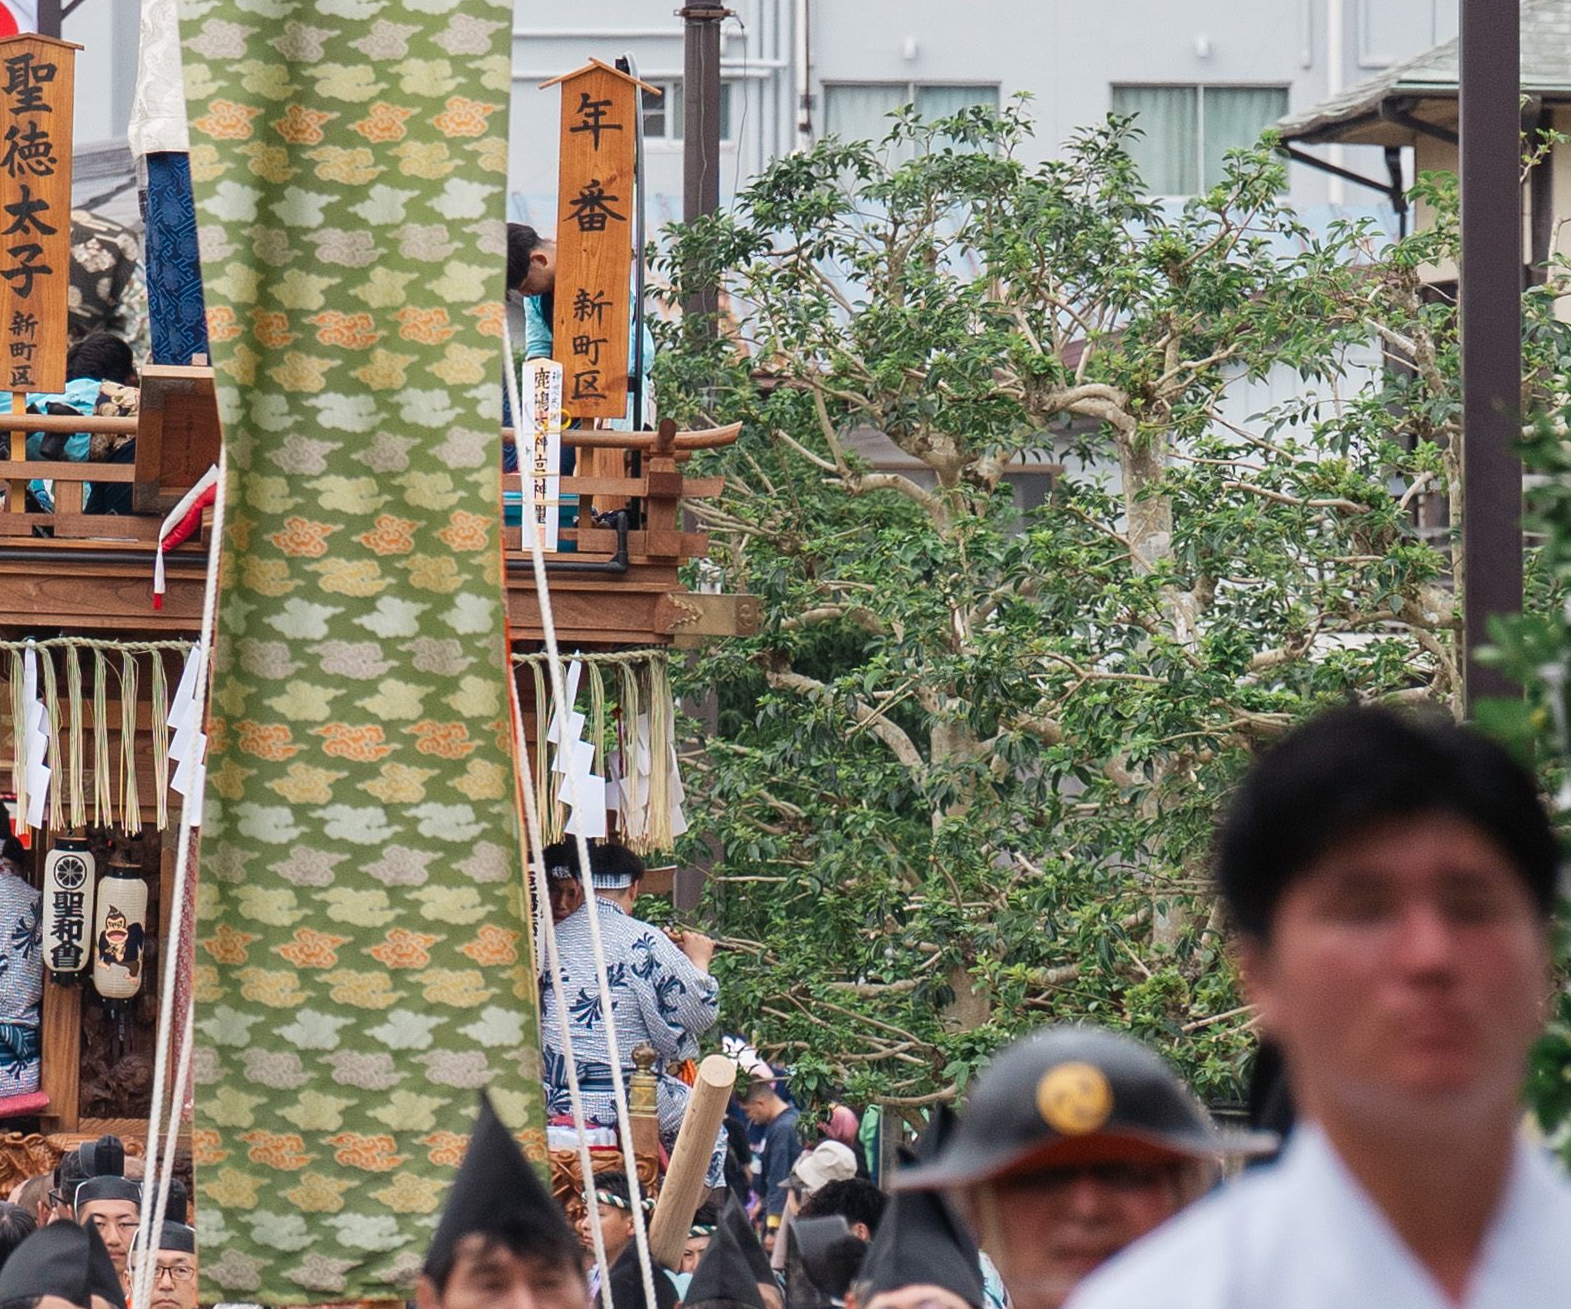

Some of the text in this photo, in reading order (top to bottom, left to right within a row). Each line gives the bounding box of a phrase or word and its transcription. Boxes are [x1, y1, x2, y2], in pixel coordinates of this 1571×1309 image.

[0, 52, 58, 387] 聖徳太子 新町区
[563, 92, 627, 401] 年番 新町区
